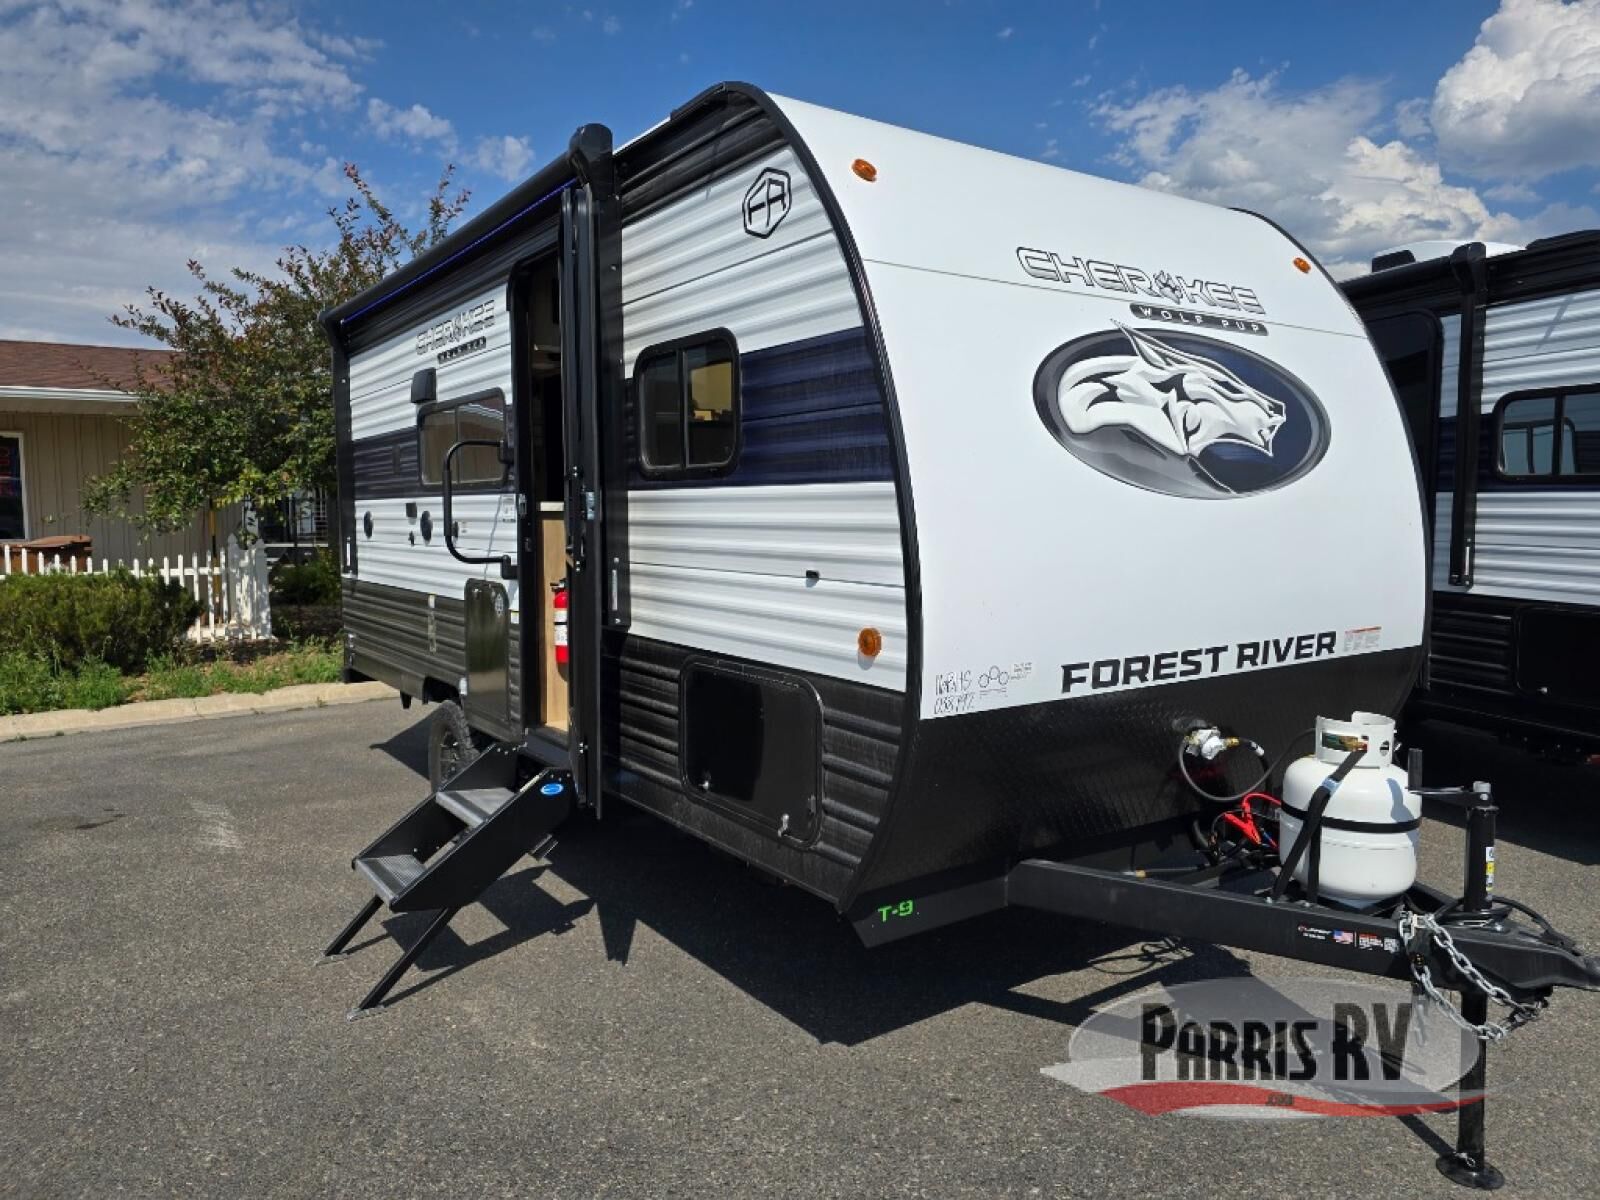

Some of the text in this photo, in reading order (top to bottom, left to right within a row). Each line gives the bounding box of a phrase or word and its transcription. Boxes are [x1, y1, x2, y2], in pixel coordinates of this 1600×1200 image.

[1139, 305, 1260, 333] WOLF PUP
[1061, 644, 1228, 694] FOREST
[1236, 630, 1337, 669] RIVER
[878, 899, 915, 923] T-9
